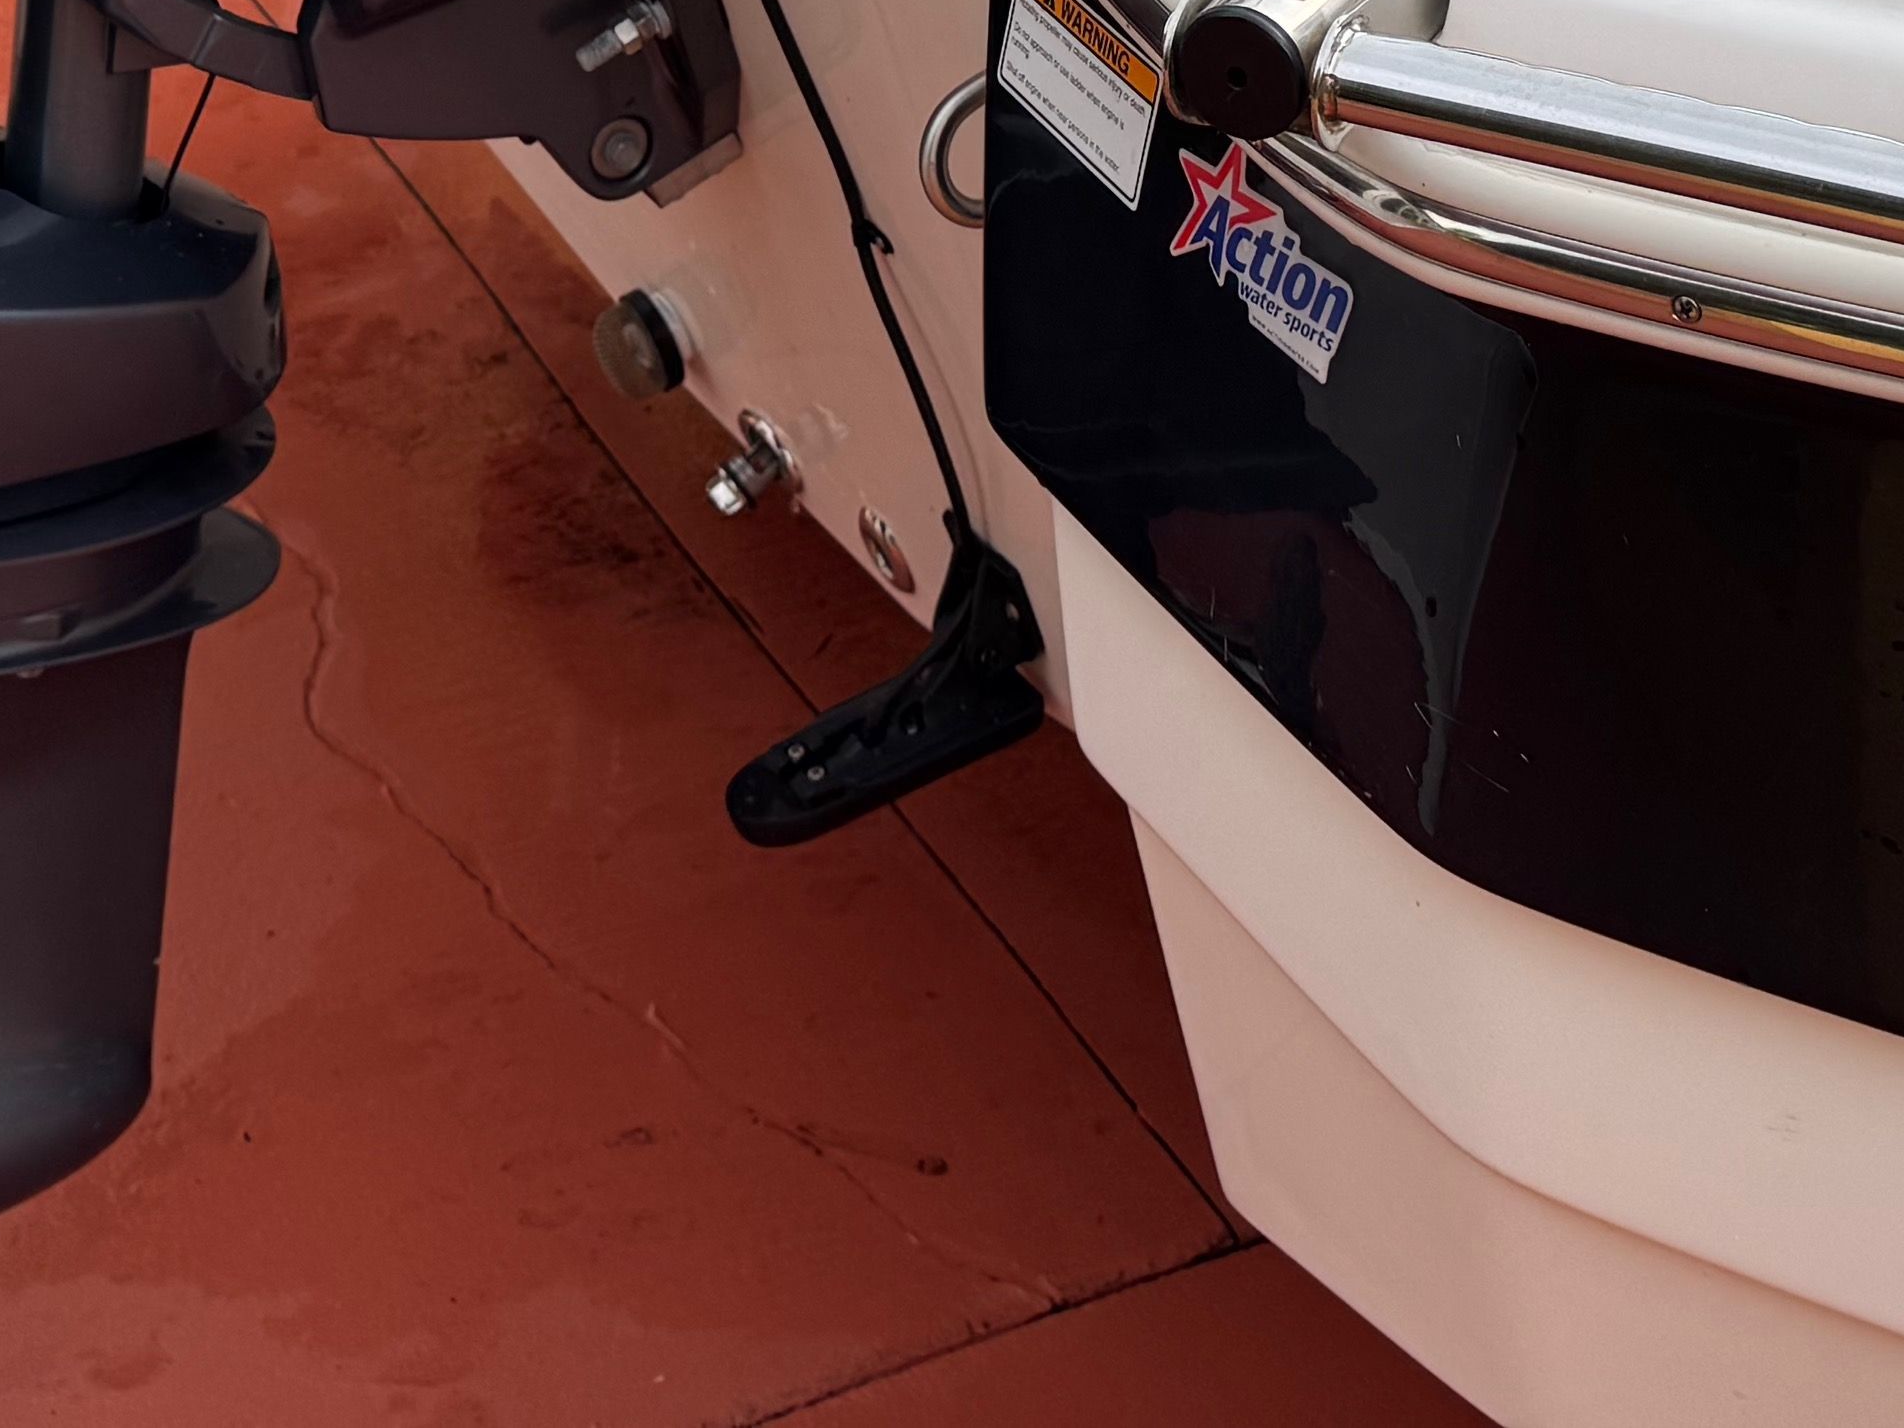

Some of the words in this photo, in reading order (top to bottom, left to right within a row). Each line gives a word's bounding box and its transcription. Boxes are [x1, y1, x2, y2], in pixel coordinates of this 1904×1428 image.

[1191, 194, 1350, 334] Action
[1240, 282, 1283, 317] water
[1283, 310, 1335, 352] sports
